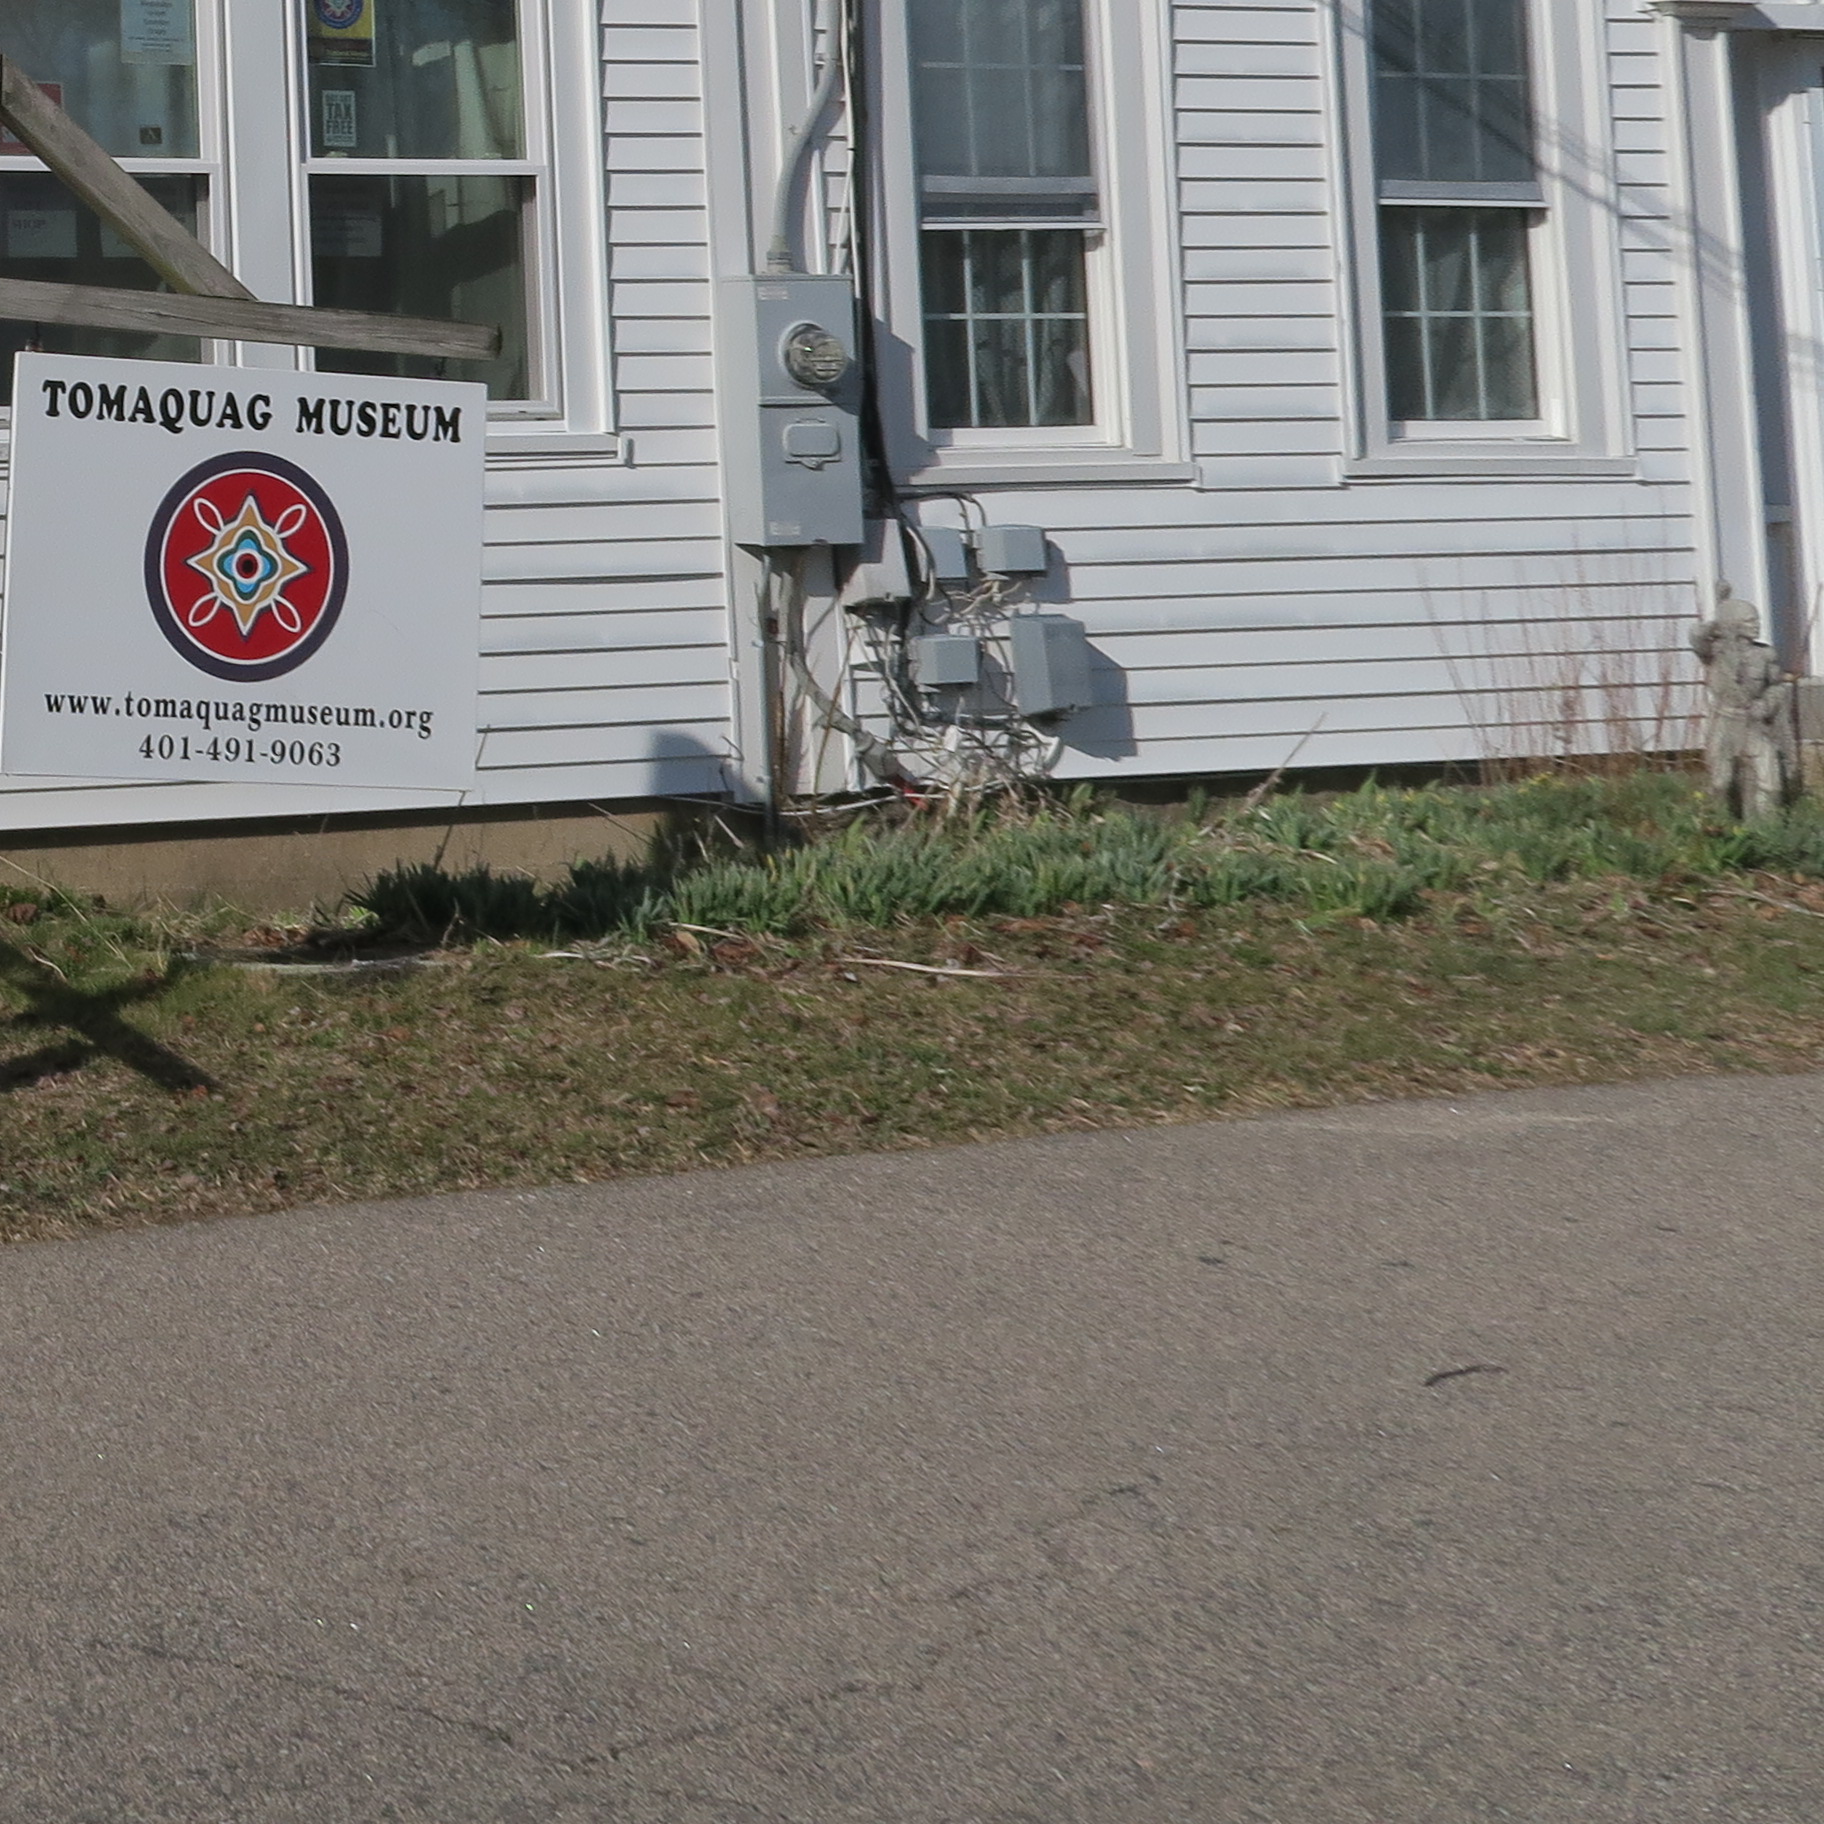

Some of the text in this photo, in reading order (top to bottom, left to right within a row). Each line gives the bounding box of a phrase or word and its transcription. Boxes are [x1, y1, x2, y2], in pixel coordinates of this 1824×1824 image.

[42, 379, 462, 443] TOMAQUAG MUSEUM
[43, 690, 435, 740] www.tomaquagmuseum.org
[138, 733, 342, 768] 401-491-9063
